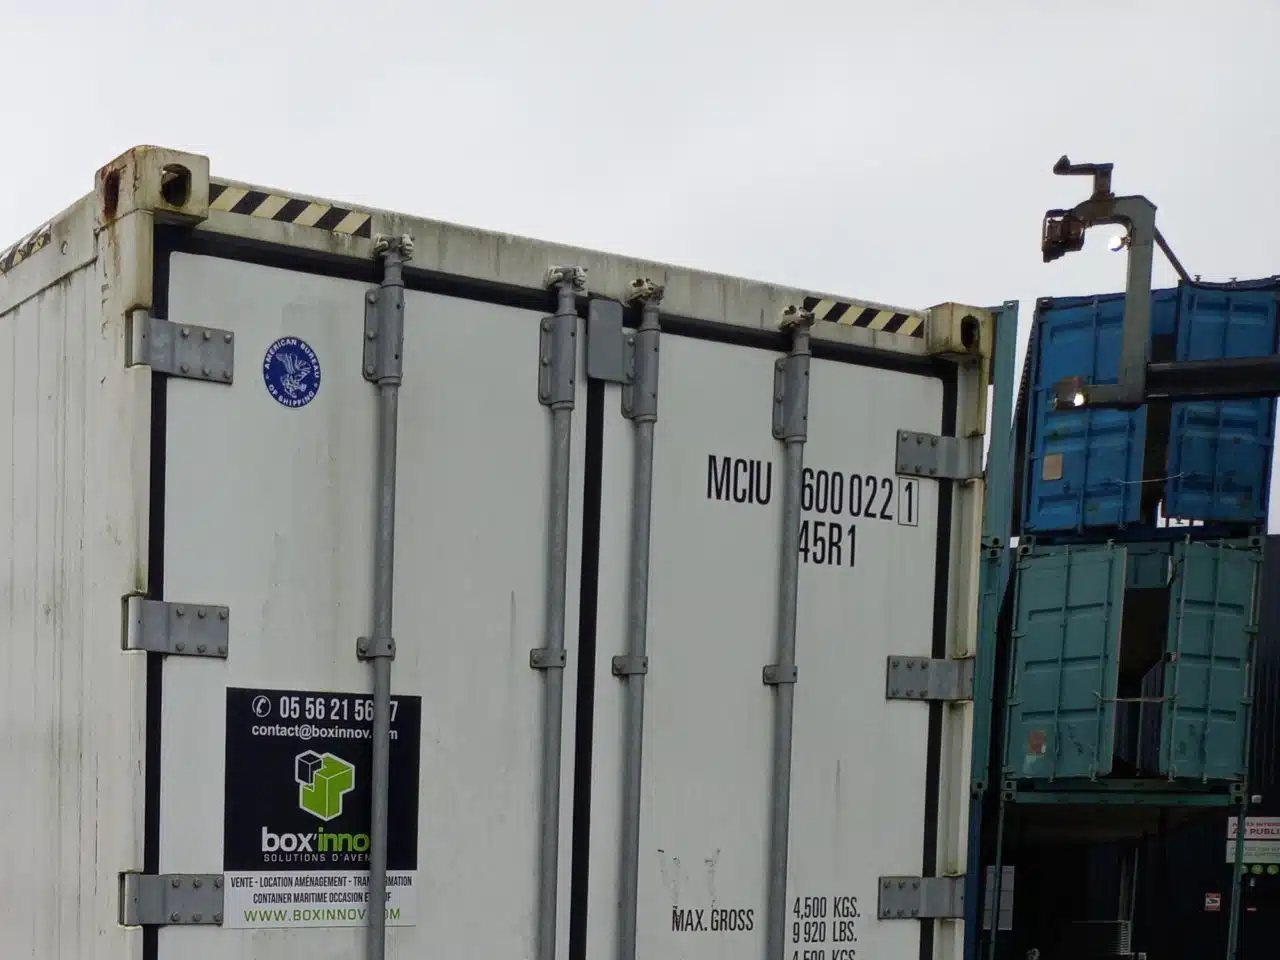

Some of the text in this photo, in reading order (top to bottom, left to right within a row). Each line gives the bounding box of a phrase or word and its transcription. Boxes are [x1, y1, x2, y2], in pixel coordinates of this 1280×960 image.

[265, 339, 319, 378] AMERICAN BUREAU
[278, 390, 314, 406] SHIPPING
[707, 454, 772, 505] MCIU
[799, 520, 856, 568] 45R1
[279, 696, 300, 718] 05
[305, 697, 325, 720] 56
[330, 698, 348, 720] 21
[354, 699, 374, 721] 56
[251, 724, 398, 740] contact@boxinnov.m
[261, 826, 370, 852] box'inno
[263, 853, 371, 862] SOLUTIONS D'AVEN
[230, 876, 254, 888] VENTE
[259, 876, 293, 888] LOCATION
[294, 874, 347, 887] AMÉNAGEMENT
[253, 892, 292, 904] CONTAINER
[293, 892, 328, 903] MARITIME
[329, 892, 364, 903] OCCASION
[793, 896, 860, 920] 4,500 KGS.
[672, 908, 754, 932] MAX. GROSS
[832, 921, 857, 942] LBS.
